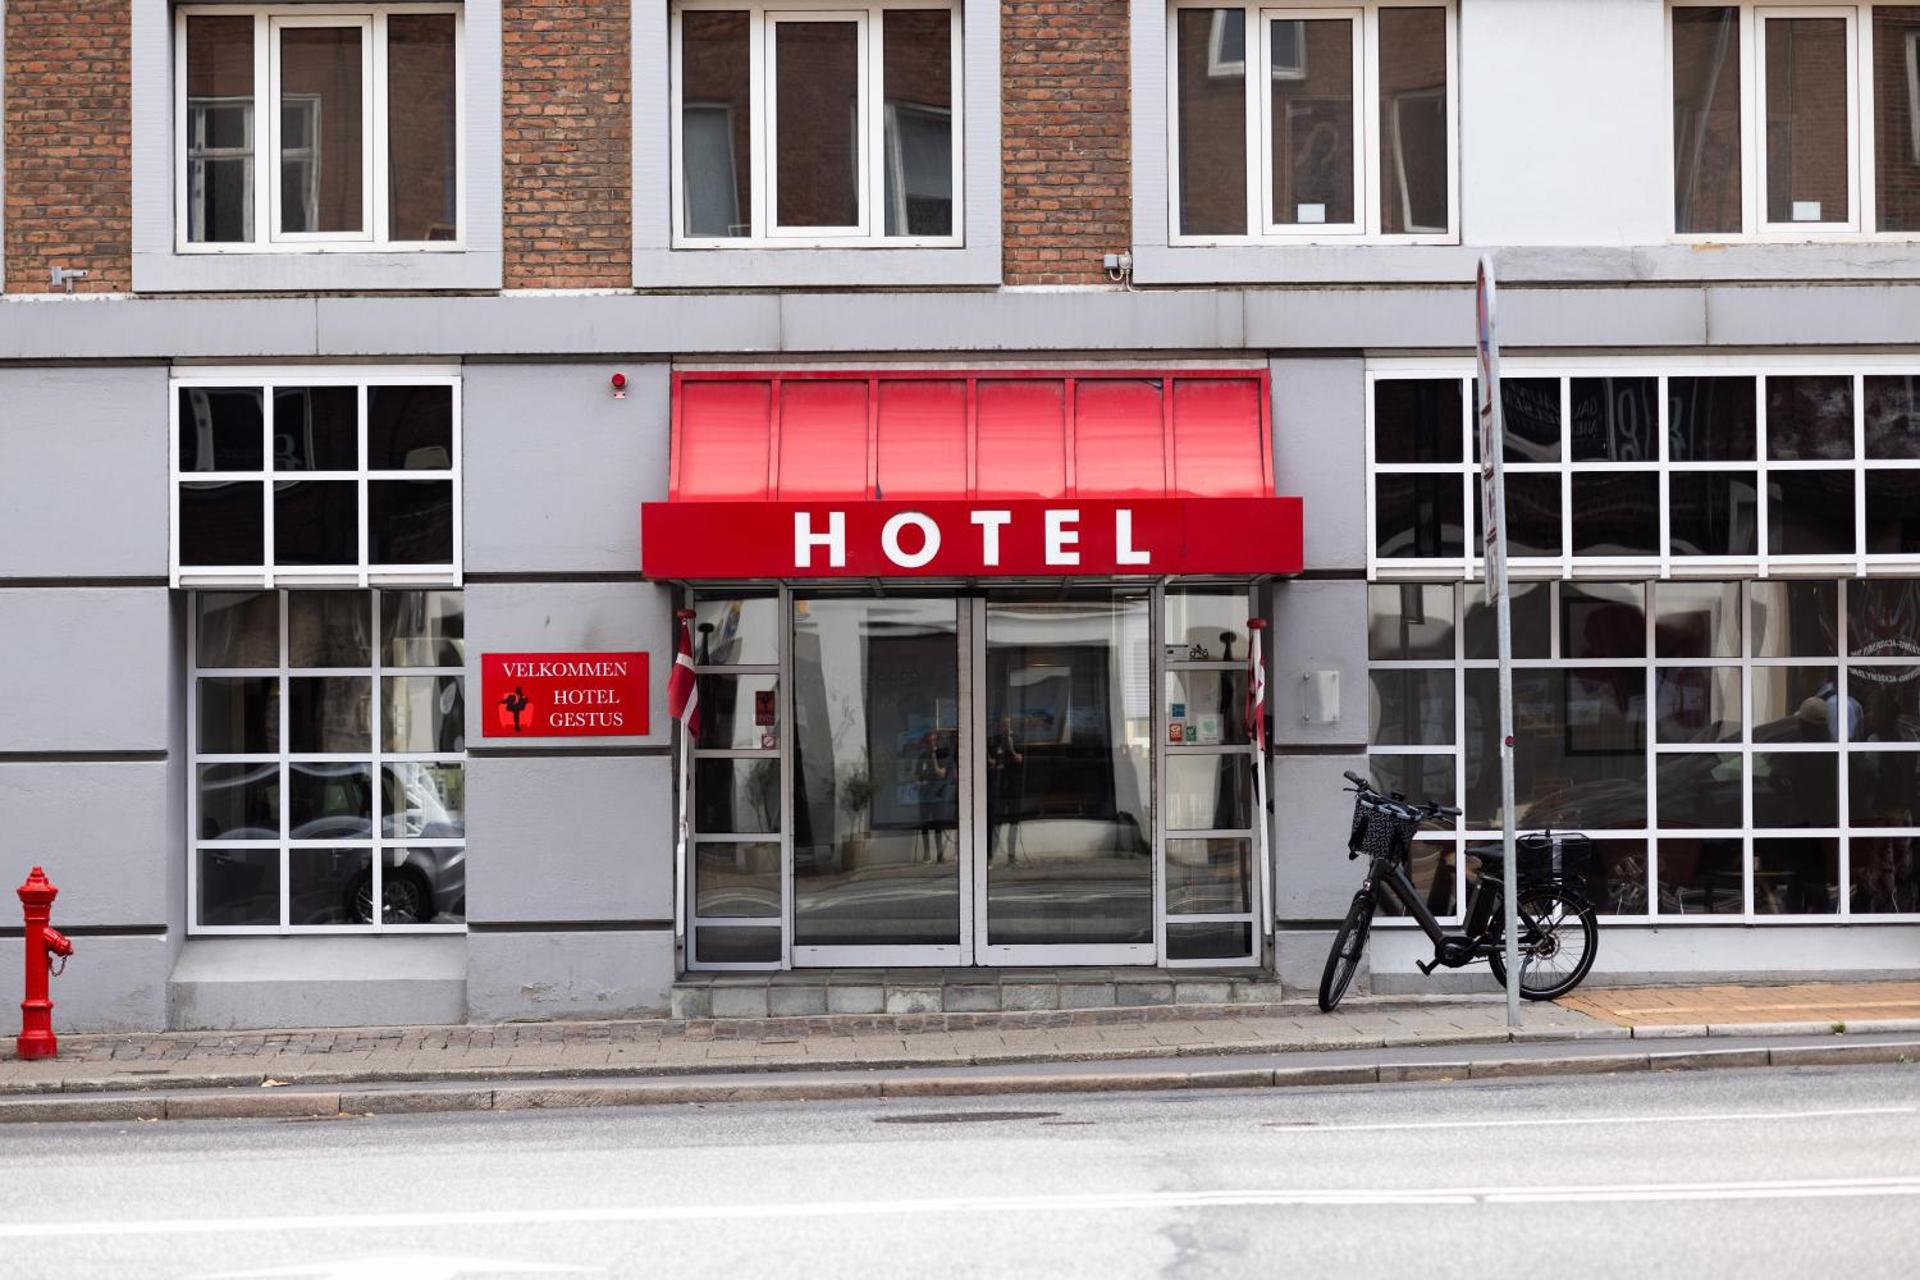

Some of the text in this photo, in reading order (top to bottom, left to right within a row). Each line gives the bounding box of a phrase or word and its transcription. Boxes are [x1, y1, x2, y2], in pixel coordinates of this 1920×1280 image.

[793, 509, 1151, 568] HOTEL
[502, 661, 627, 678] VELKOMMEN
[553, 689, 620, 705] HOTEL
[549, 712, 623, 727] GESTUS
